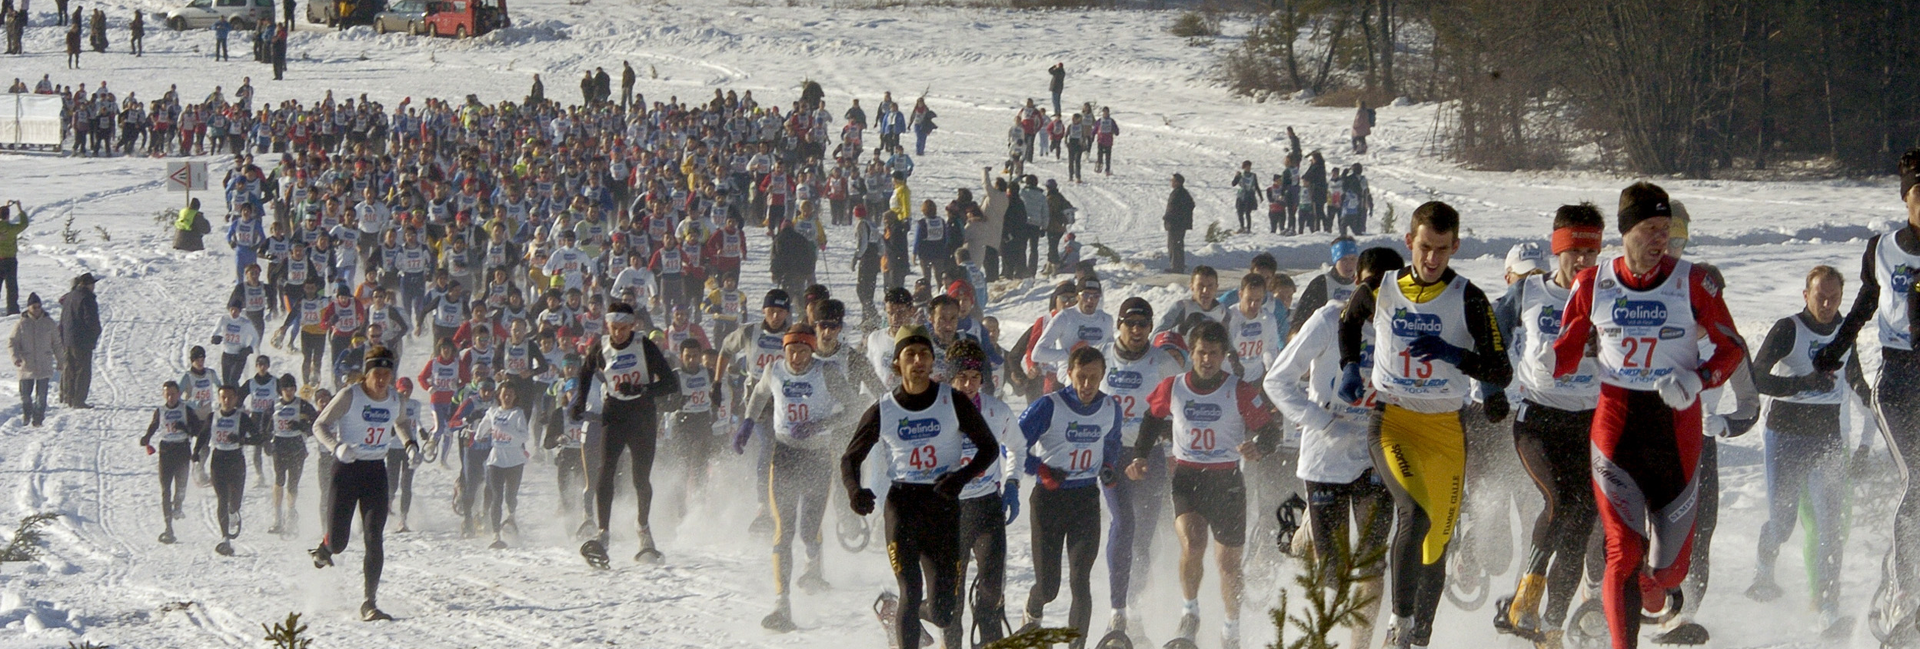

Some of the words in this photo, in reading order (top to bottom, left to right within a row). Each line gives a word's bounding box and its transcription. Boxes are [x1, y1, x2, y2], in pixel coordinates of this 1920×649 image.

[1614, 305, 1667, 320] Melinda
[1394, 315, 1442, 332] Melinda
[1238, 340, 1263, 357] 378
[1621, 337, 1658, 368] 27
[1398, 346, 1433, 379] 13
[691, 391, 706, 404] 62
[787, 403, 808, 422] 50
[365, 427, 385, 445] 37
[899, 421, 940, 436] Melinda
[1190, 428, 1215, 450] 20
[909, 445, 937, 470] 43
[1069, 448, 1092, 471] 10
[1391, 443, 1414, 478] sportful
[1450, 475, 1460, 504] GIALLE
